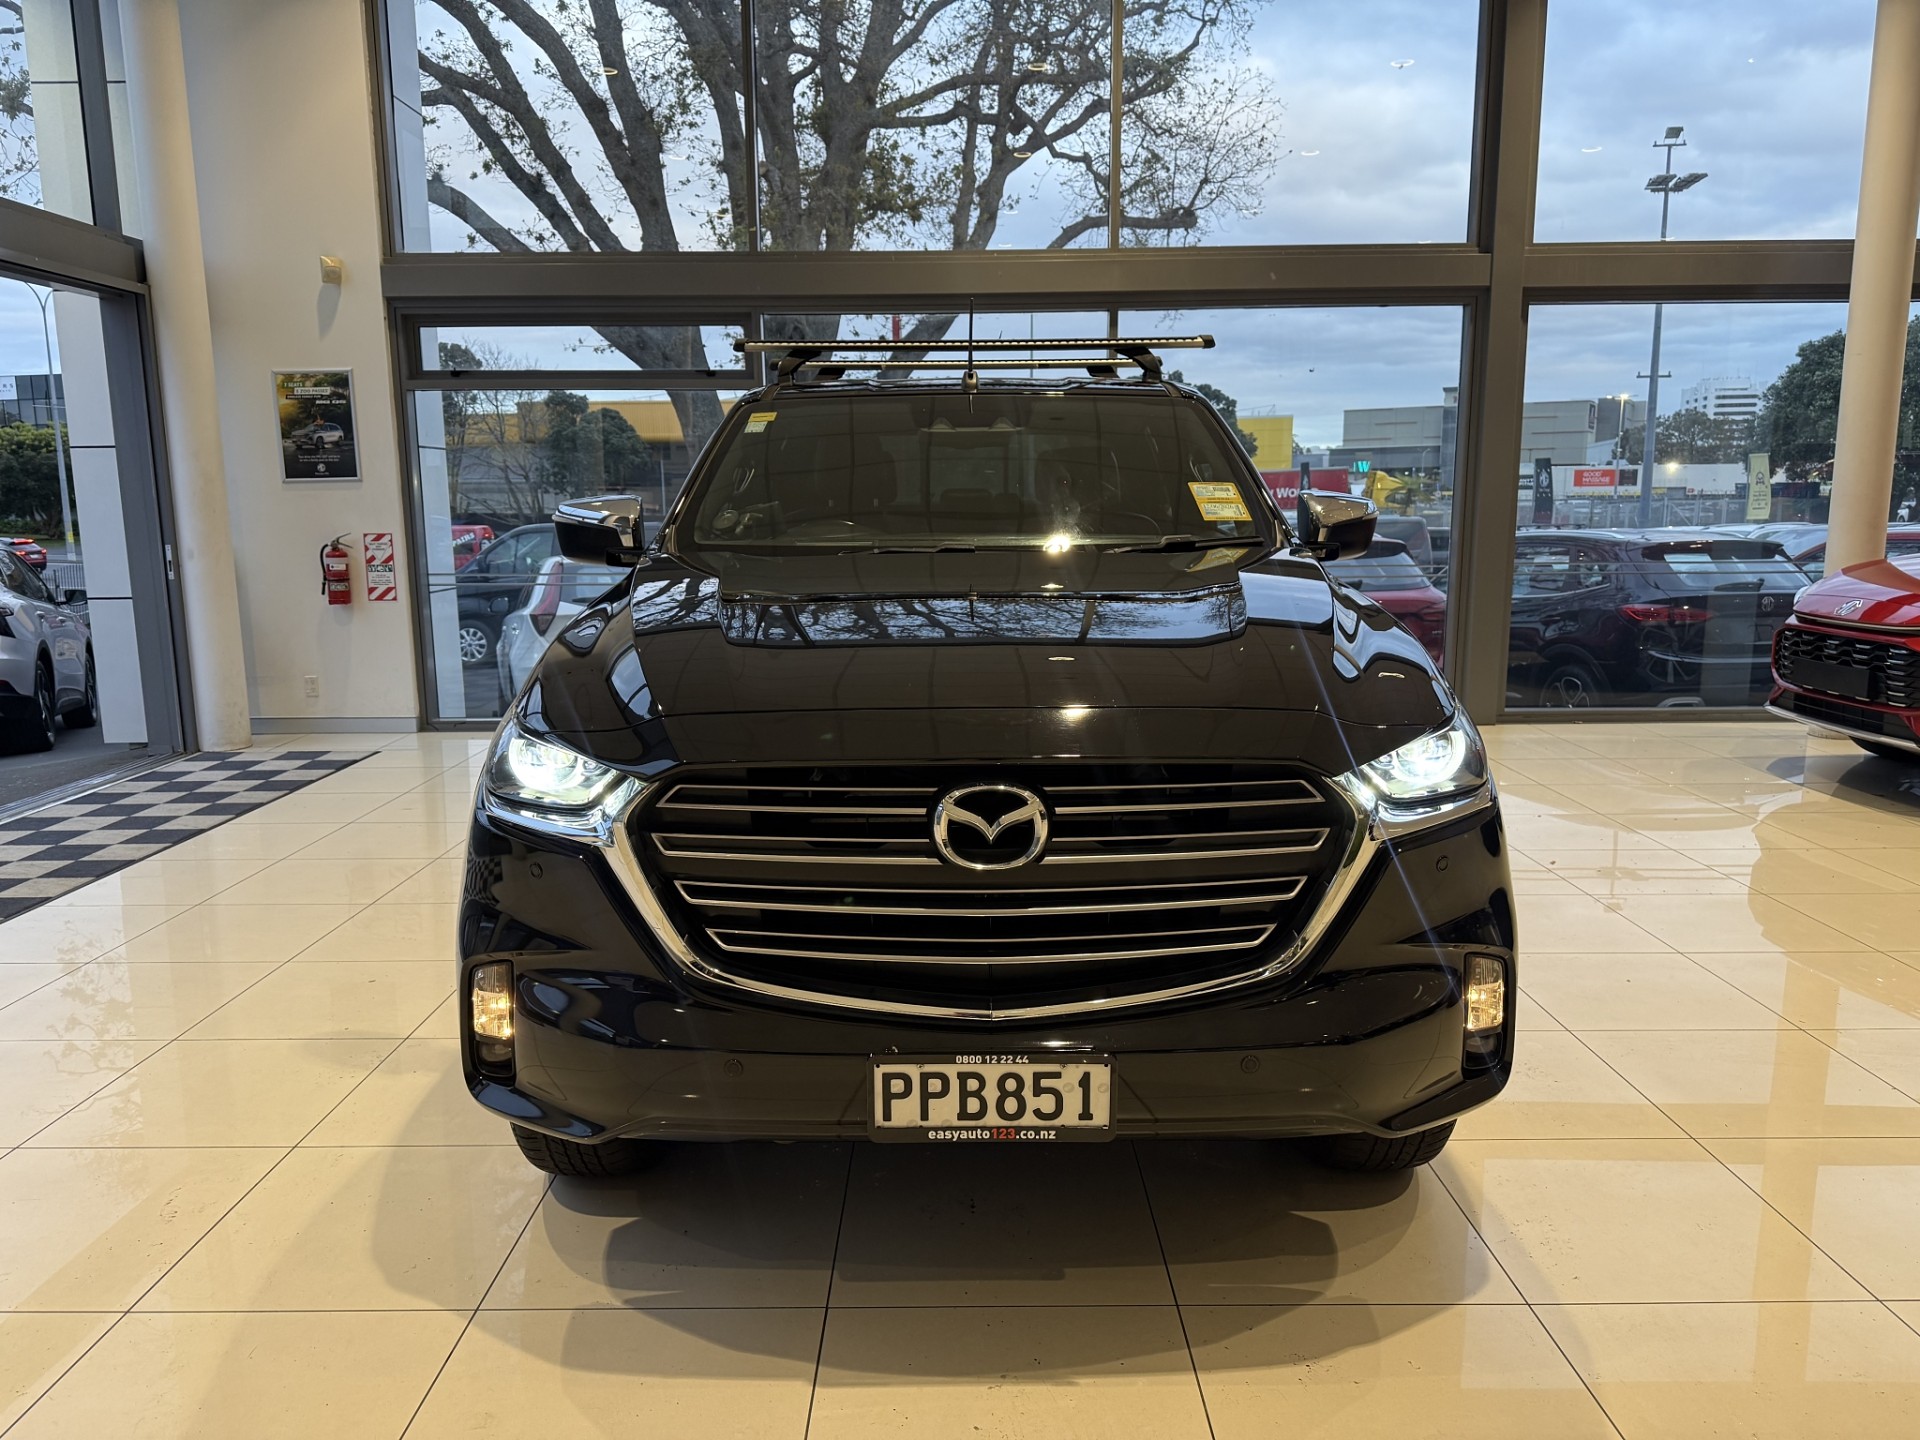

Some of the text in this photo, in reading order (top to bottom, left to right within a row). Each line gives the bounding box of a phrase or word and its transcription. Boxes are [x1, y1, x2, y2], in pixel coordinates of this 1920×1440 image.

[955, 1055, 1029, 1064] 0800 12 22 44
[881, 1071, 1094, 1122] PPB851
[928, 1128, 1057, 1142] easyauto123.co.nz
